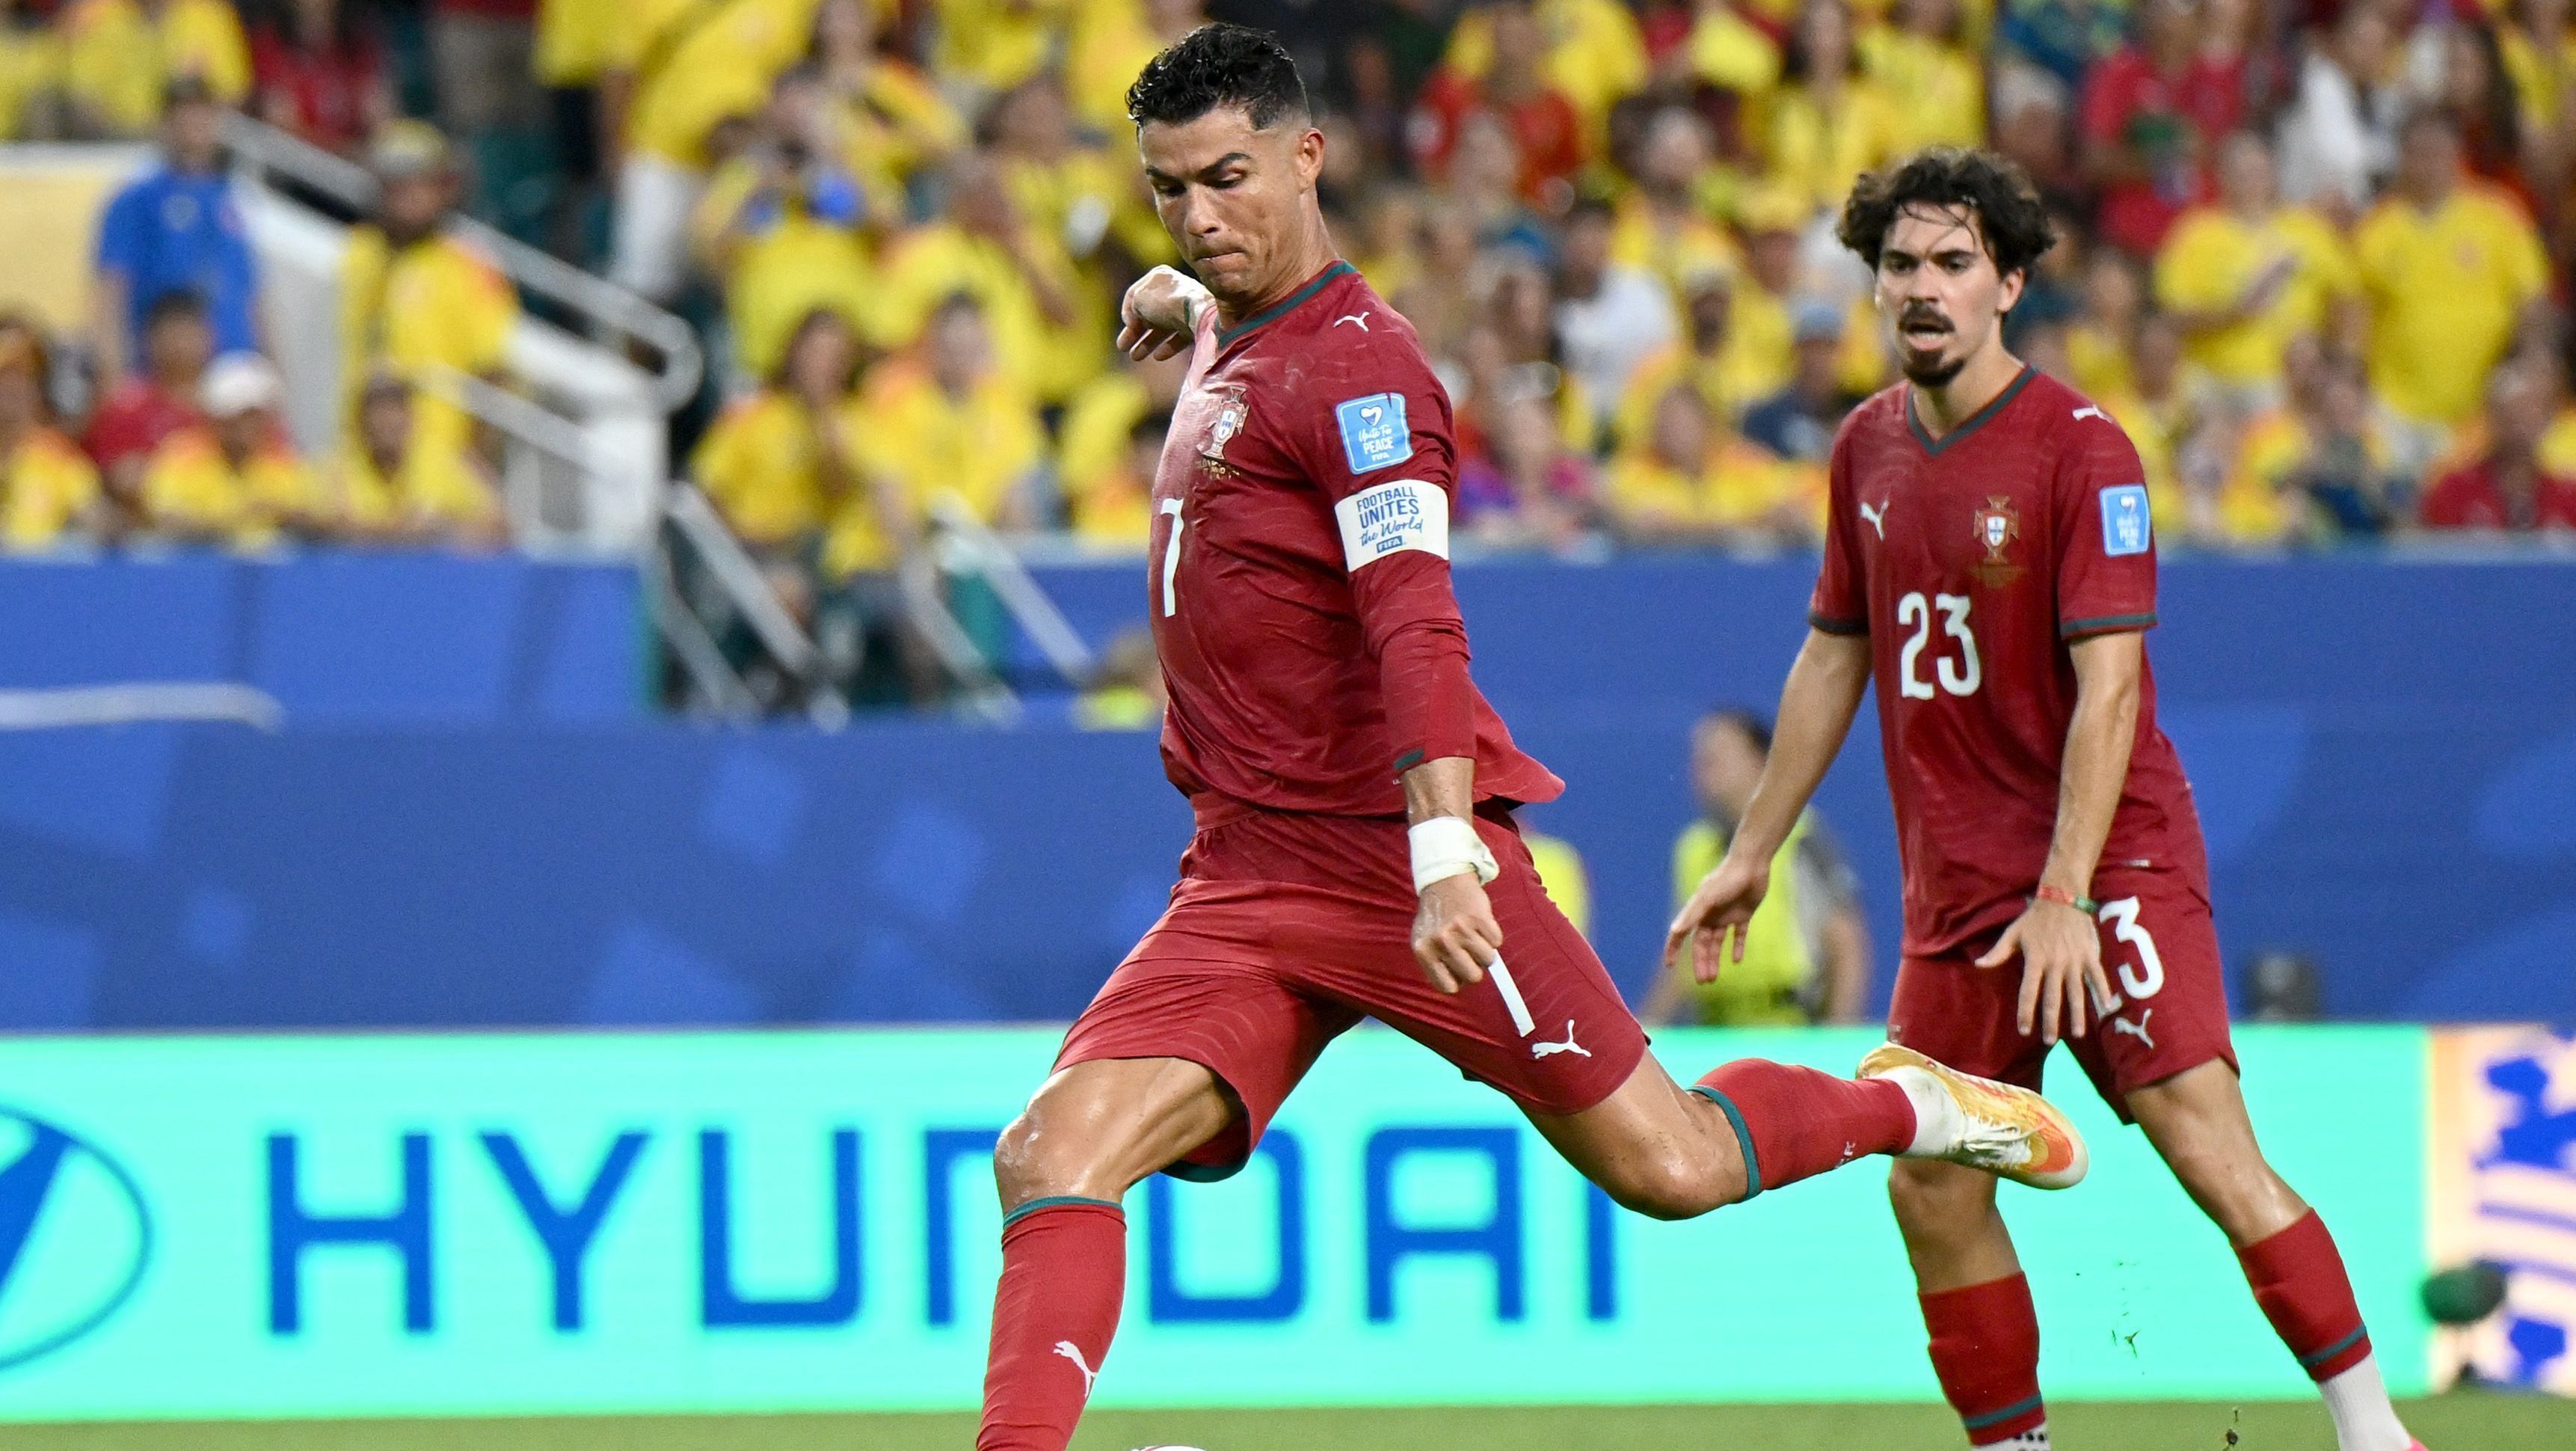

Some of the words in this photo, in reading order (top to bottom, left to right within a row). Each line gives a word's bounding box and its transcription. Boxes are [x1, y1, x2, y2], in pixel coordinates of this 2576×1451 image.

[1362, 436, 1395, 455] PEACE
[1356, 486, 1418, 512] FOOTBALL
[1359, 498, 1420, 529] UNITES
[1359, 530, 1379, 547] the
[1380, 515, 1424, 537] World
[1377, 536, 1403, 553] FIFA
[1161, 497, 1184, 618] 7
[1898, 591, 1981, 700] 23
